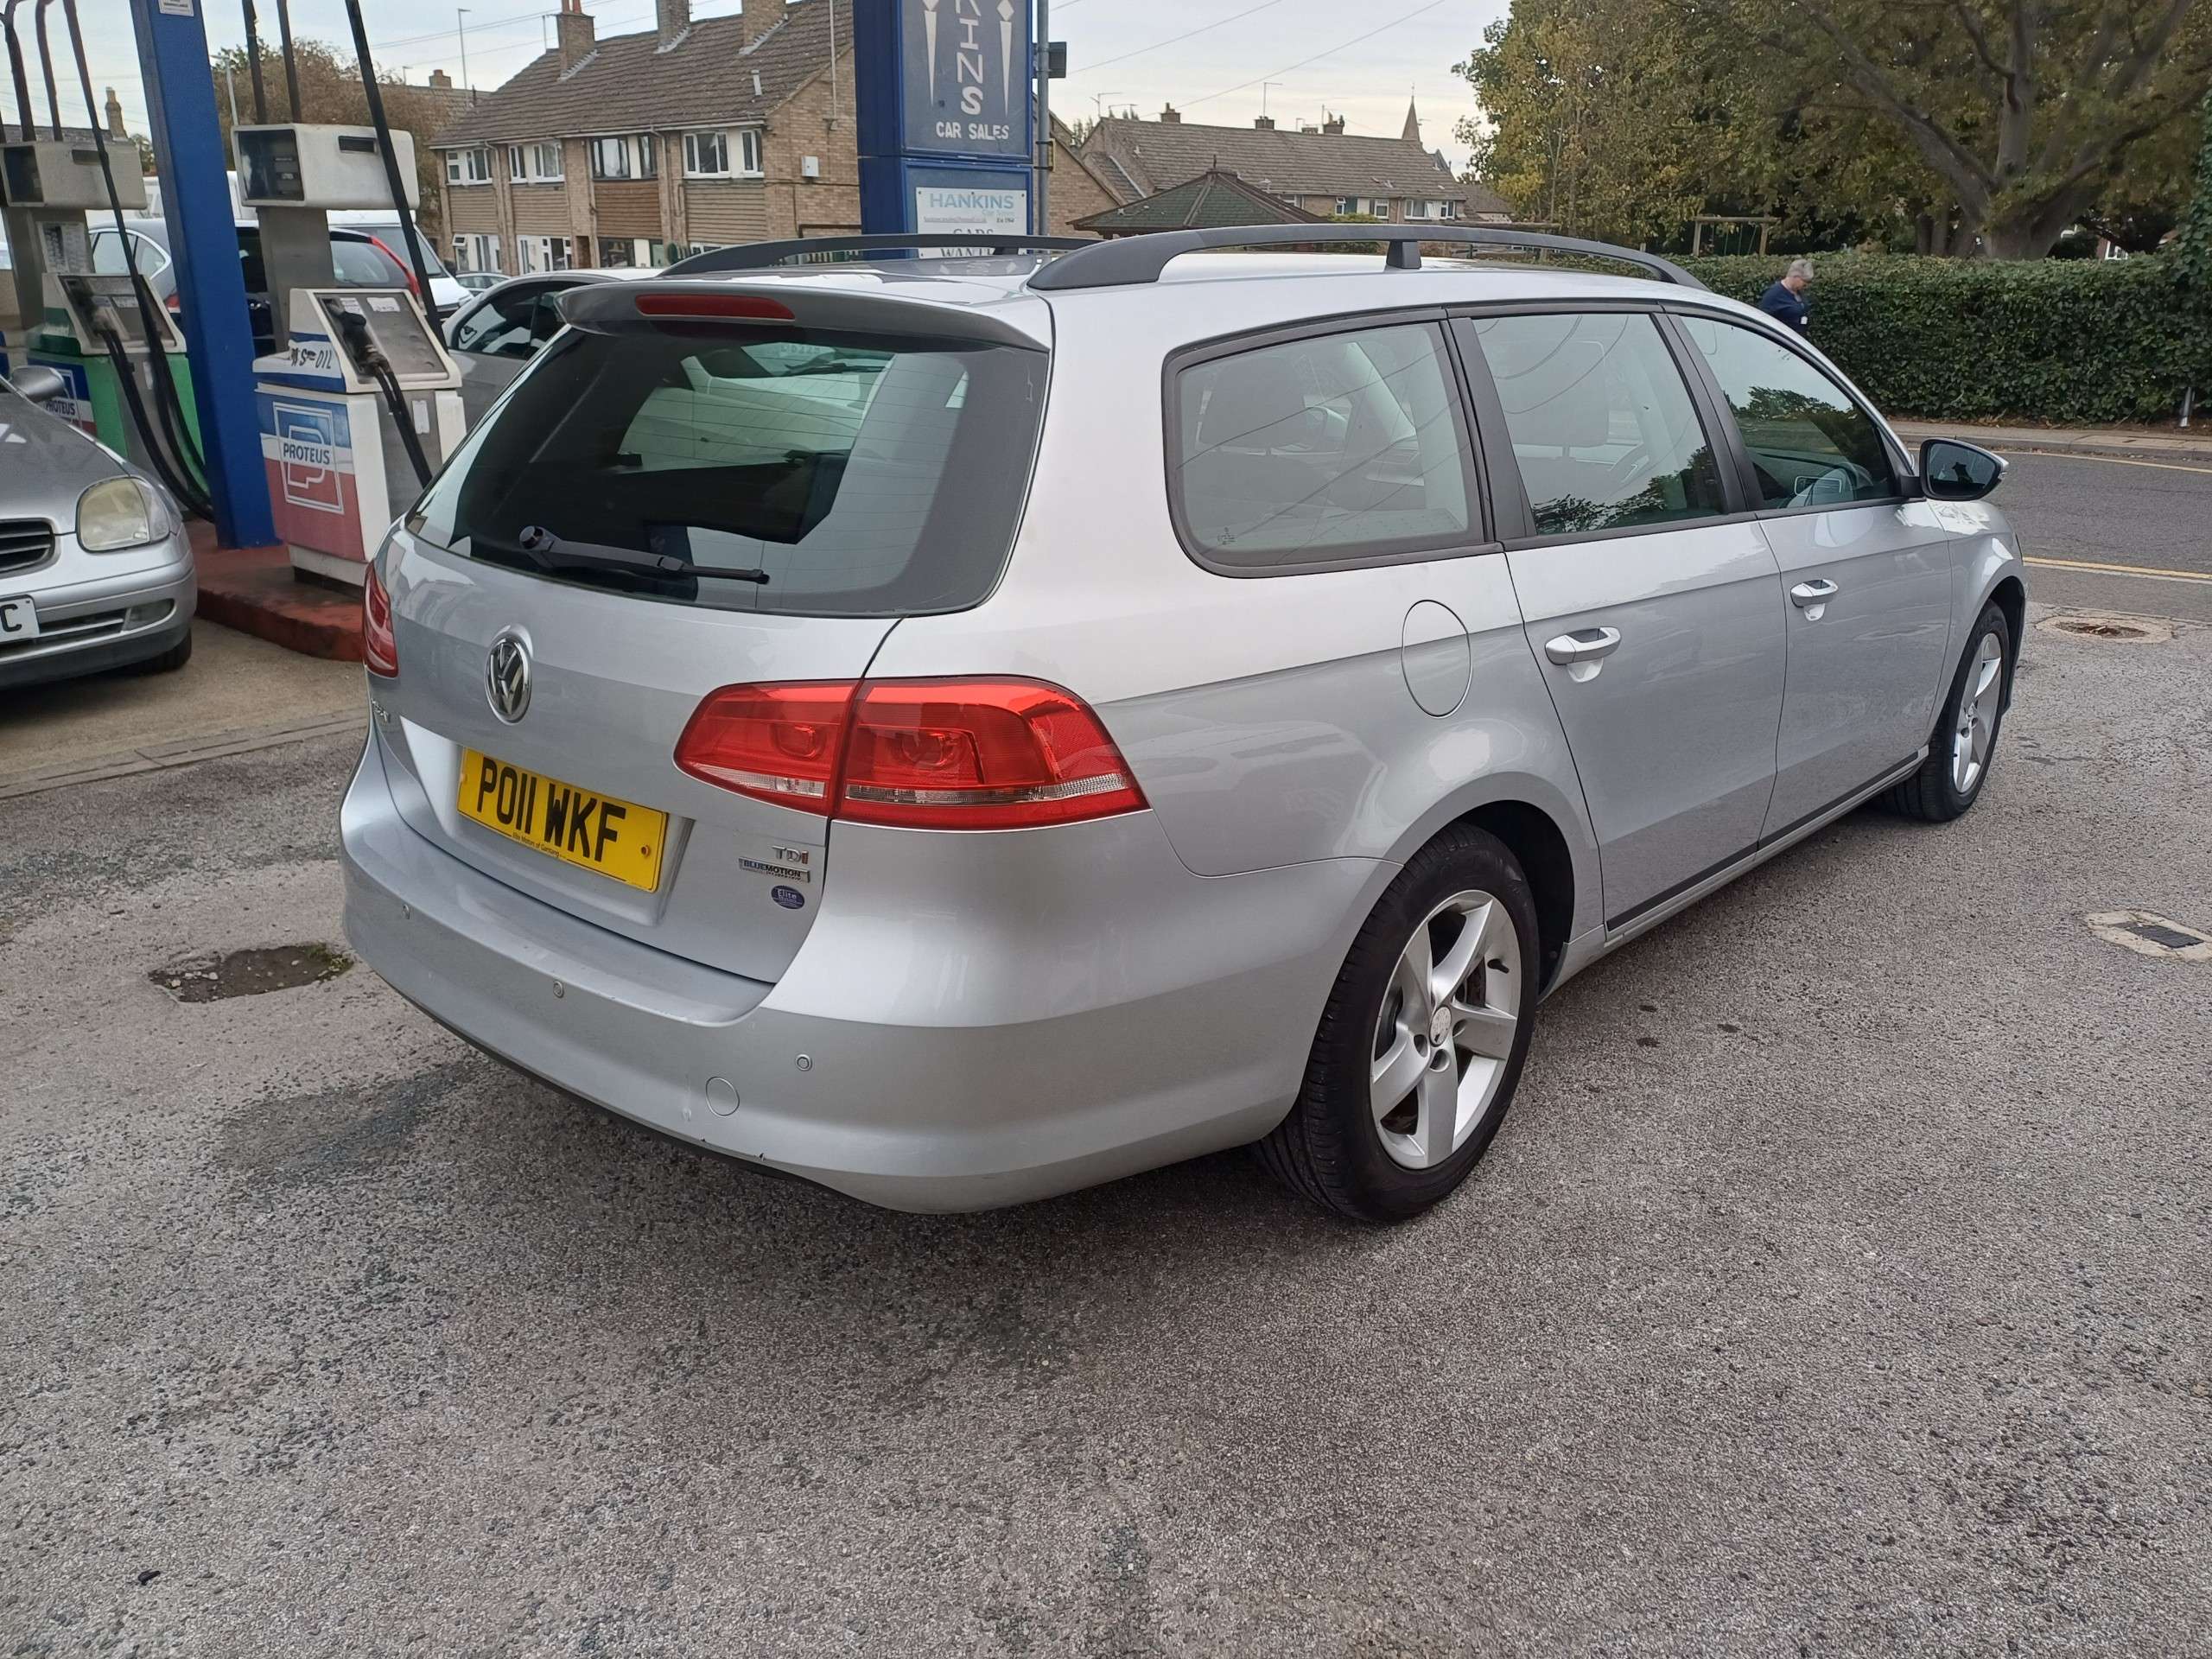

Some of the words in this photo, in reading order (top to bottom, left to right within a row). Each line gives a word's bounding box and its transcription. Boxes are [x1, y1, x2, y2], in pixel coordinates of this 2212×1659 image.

[936, 121, 962, 139] CAR
[968, 123, 1010, 141] SALES
[930, 193, 1014, 210] HANKINS
[315, 349, 333, 369] OIL
[283, 442, 330, 466] PROTEUS
[543, 783, 627, 862] WKF
[743, 859, 802, 878] BLUEMOTION
